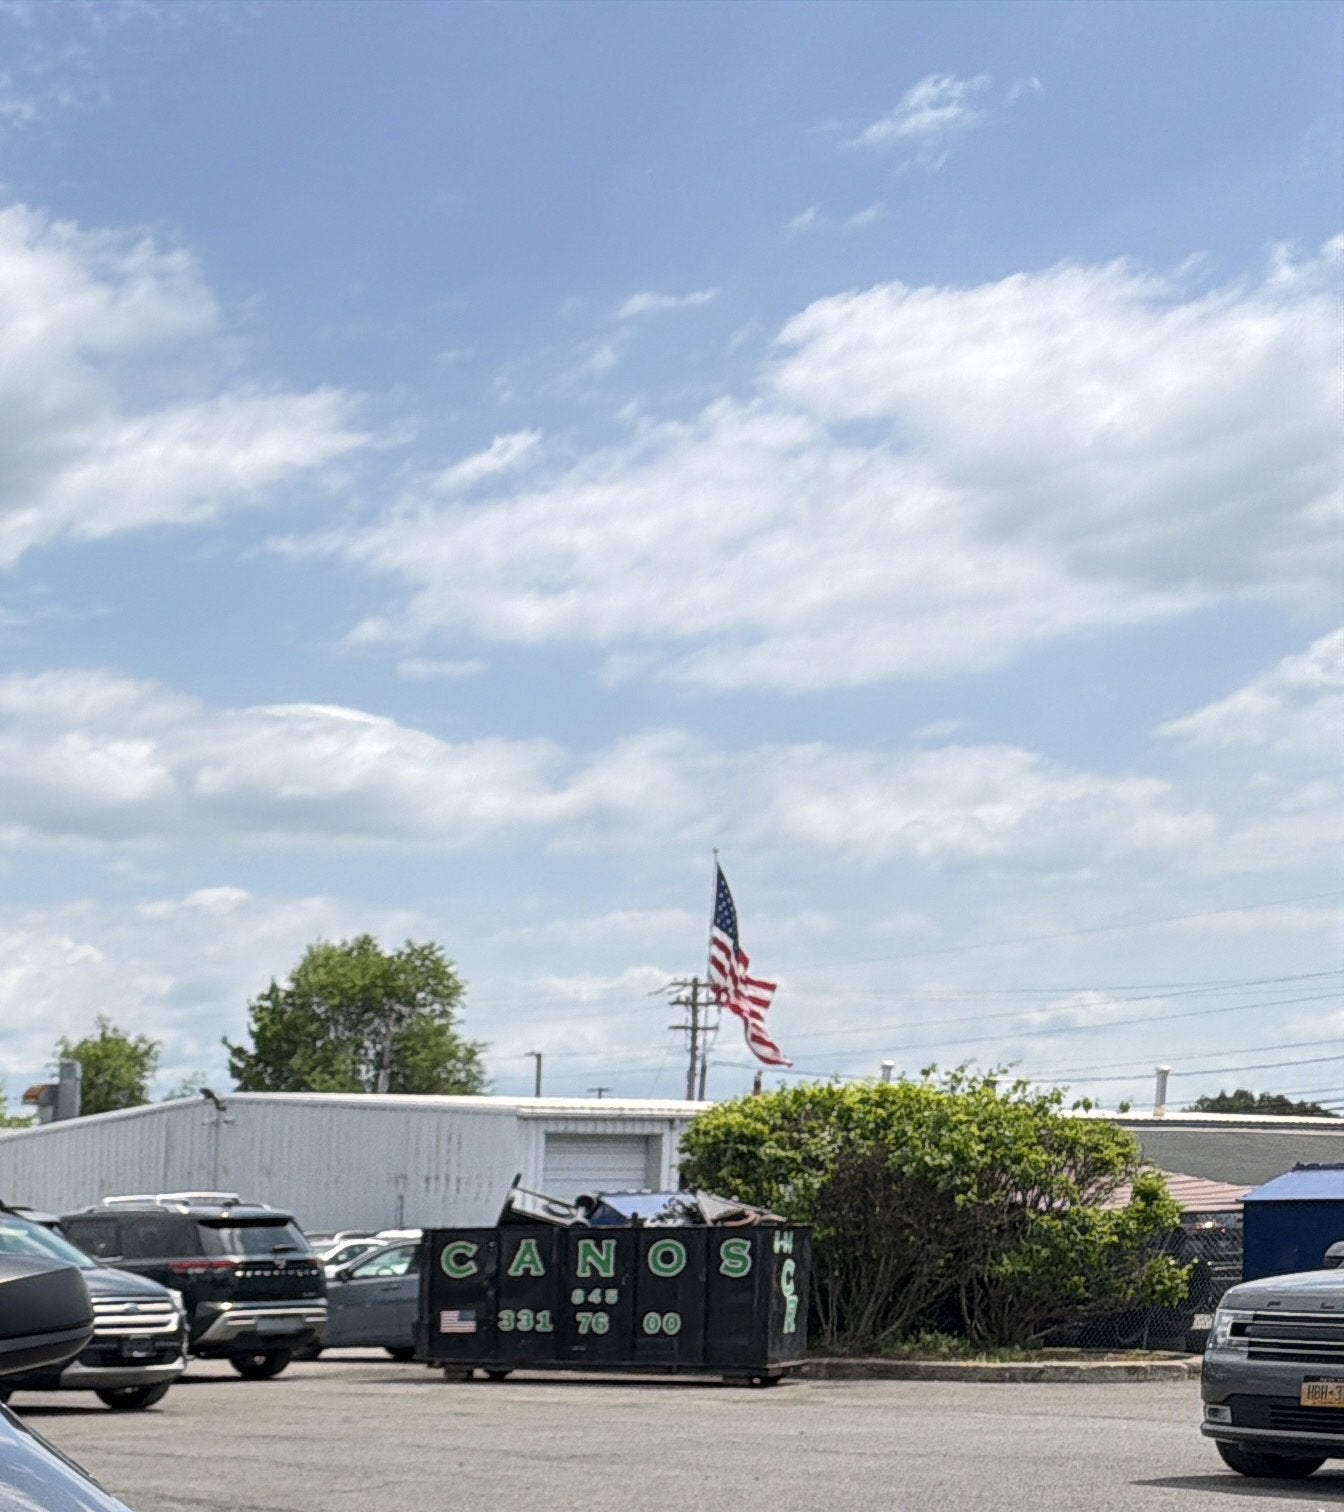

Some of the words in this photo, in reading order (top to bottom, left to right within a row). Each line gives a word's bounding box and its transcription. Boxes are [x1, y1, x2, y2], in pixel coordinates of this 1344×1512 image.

[440, 1238, 752, 1279] CANOS
[497, 1309, 554, 1333] 331
[575, 1311, 611, 1335] 76
[643, 1311, 682, 1336] 00
